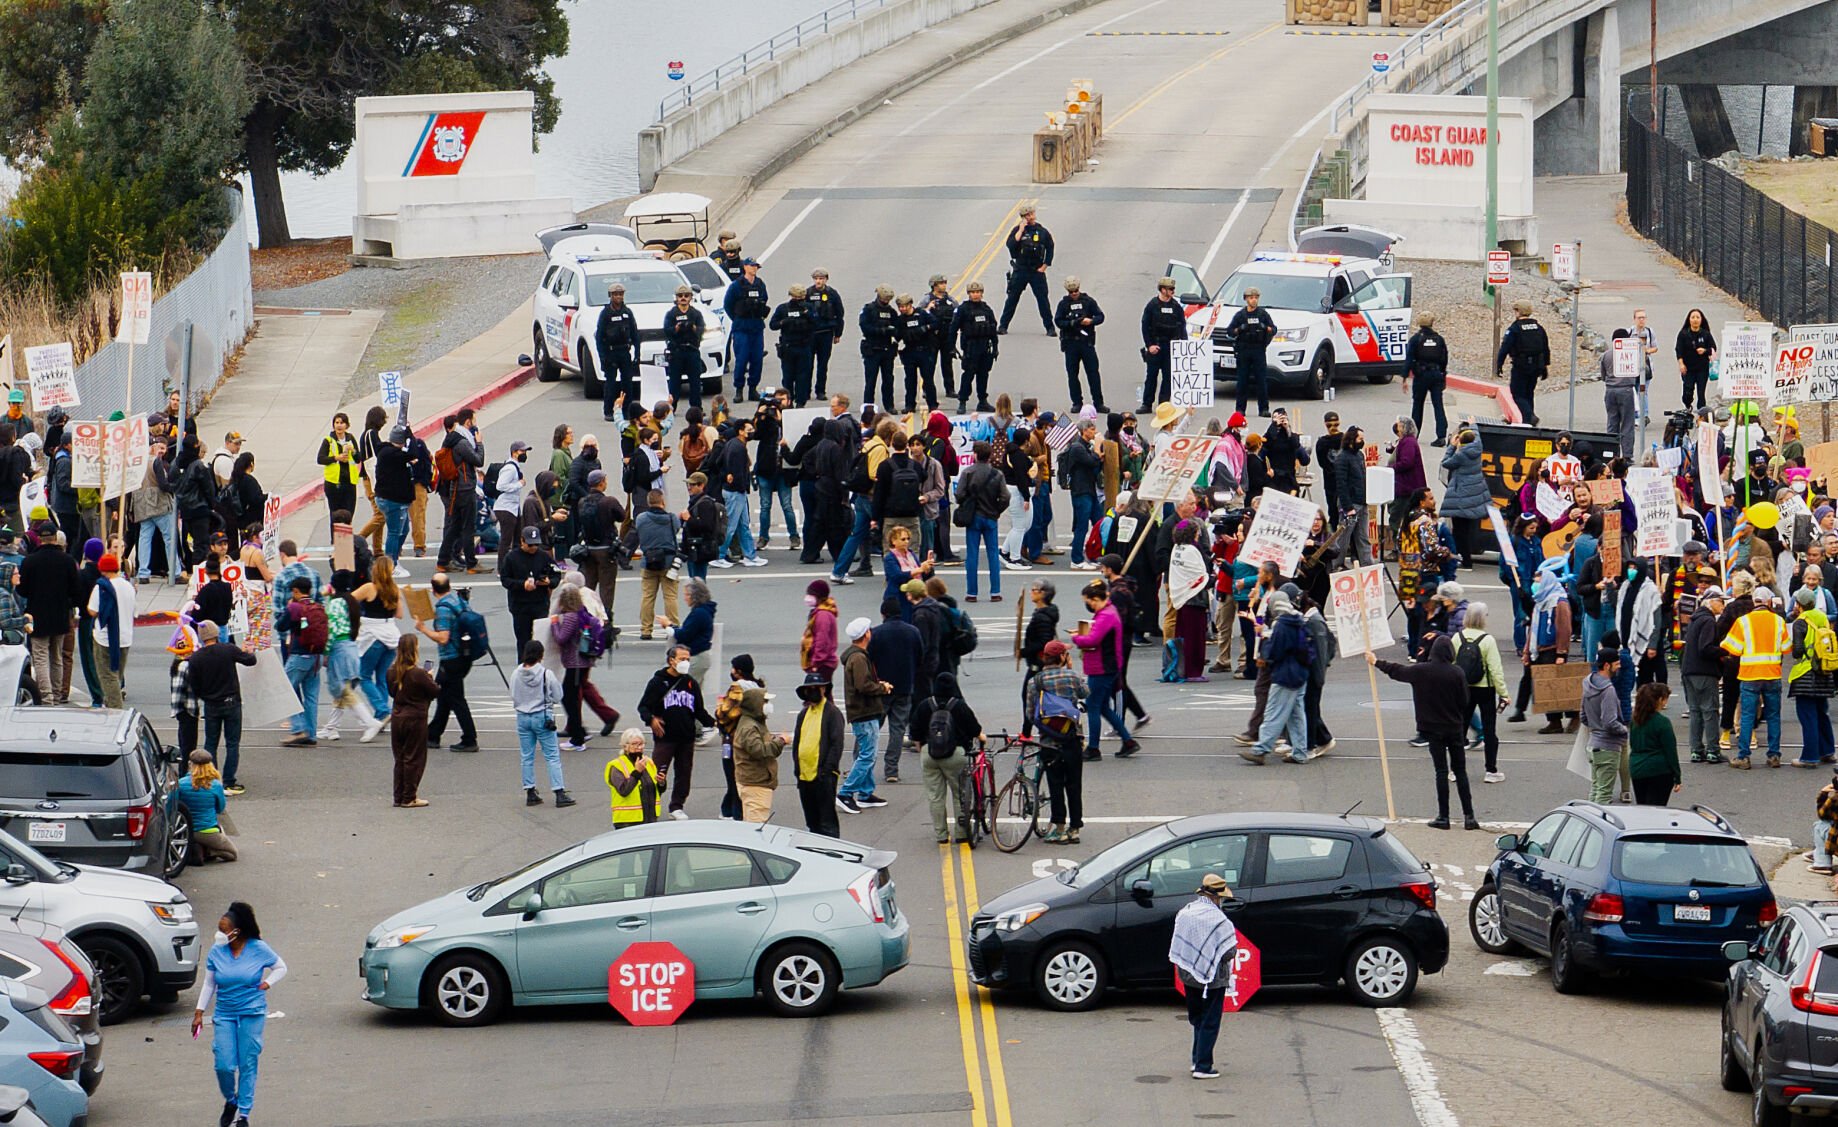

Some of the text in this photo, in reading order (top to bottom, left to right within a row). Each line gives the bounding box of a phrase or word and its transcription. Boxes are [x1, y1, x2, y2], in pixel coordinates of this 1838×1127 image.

[1390, 124, 1500, 146] COAST GUAR
[1415, 147, 1474, 166] ISLAND
[1558, 256, 1569, 265] ANY
[1557, 267, 1570, 276] TIME
[1823, 332, 1838, 345] GUA
[1172, 340, 1206, 357] FUCK
[1620, 351, 1634, 361] ANY
[1779, 346, 1814, 363] NO
[1172, 356, 1198, 373] ICE
[1619, 363, 1635, 373] TIME
[1172, 373, 1211, 390] NAZI
[1775, 374, 1808, 389] BAY!
[1173, 390, 1210, 406] SCUM
[1551, 461, 1581, 476] NO
[1589, 480, 1621, 491] ICE
[265, 496, 281, 514] NO
[619, 961, 686, 987] STOP
[631, 987, 673, 1012] ICE
